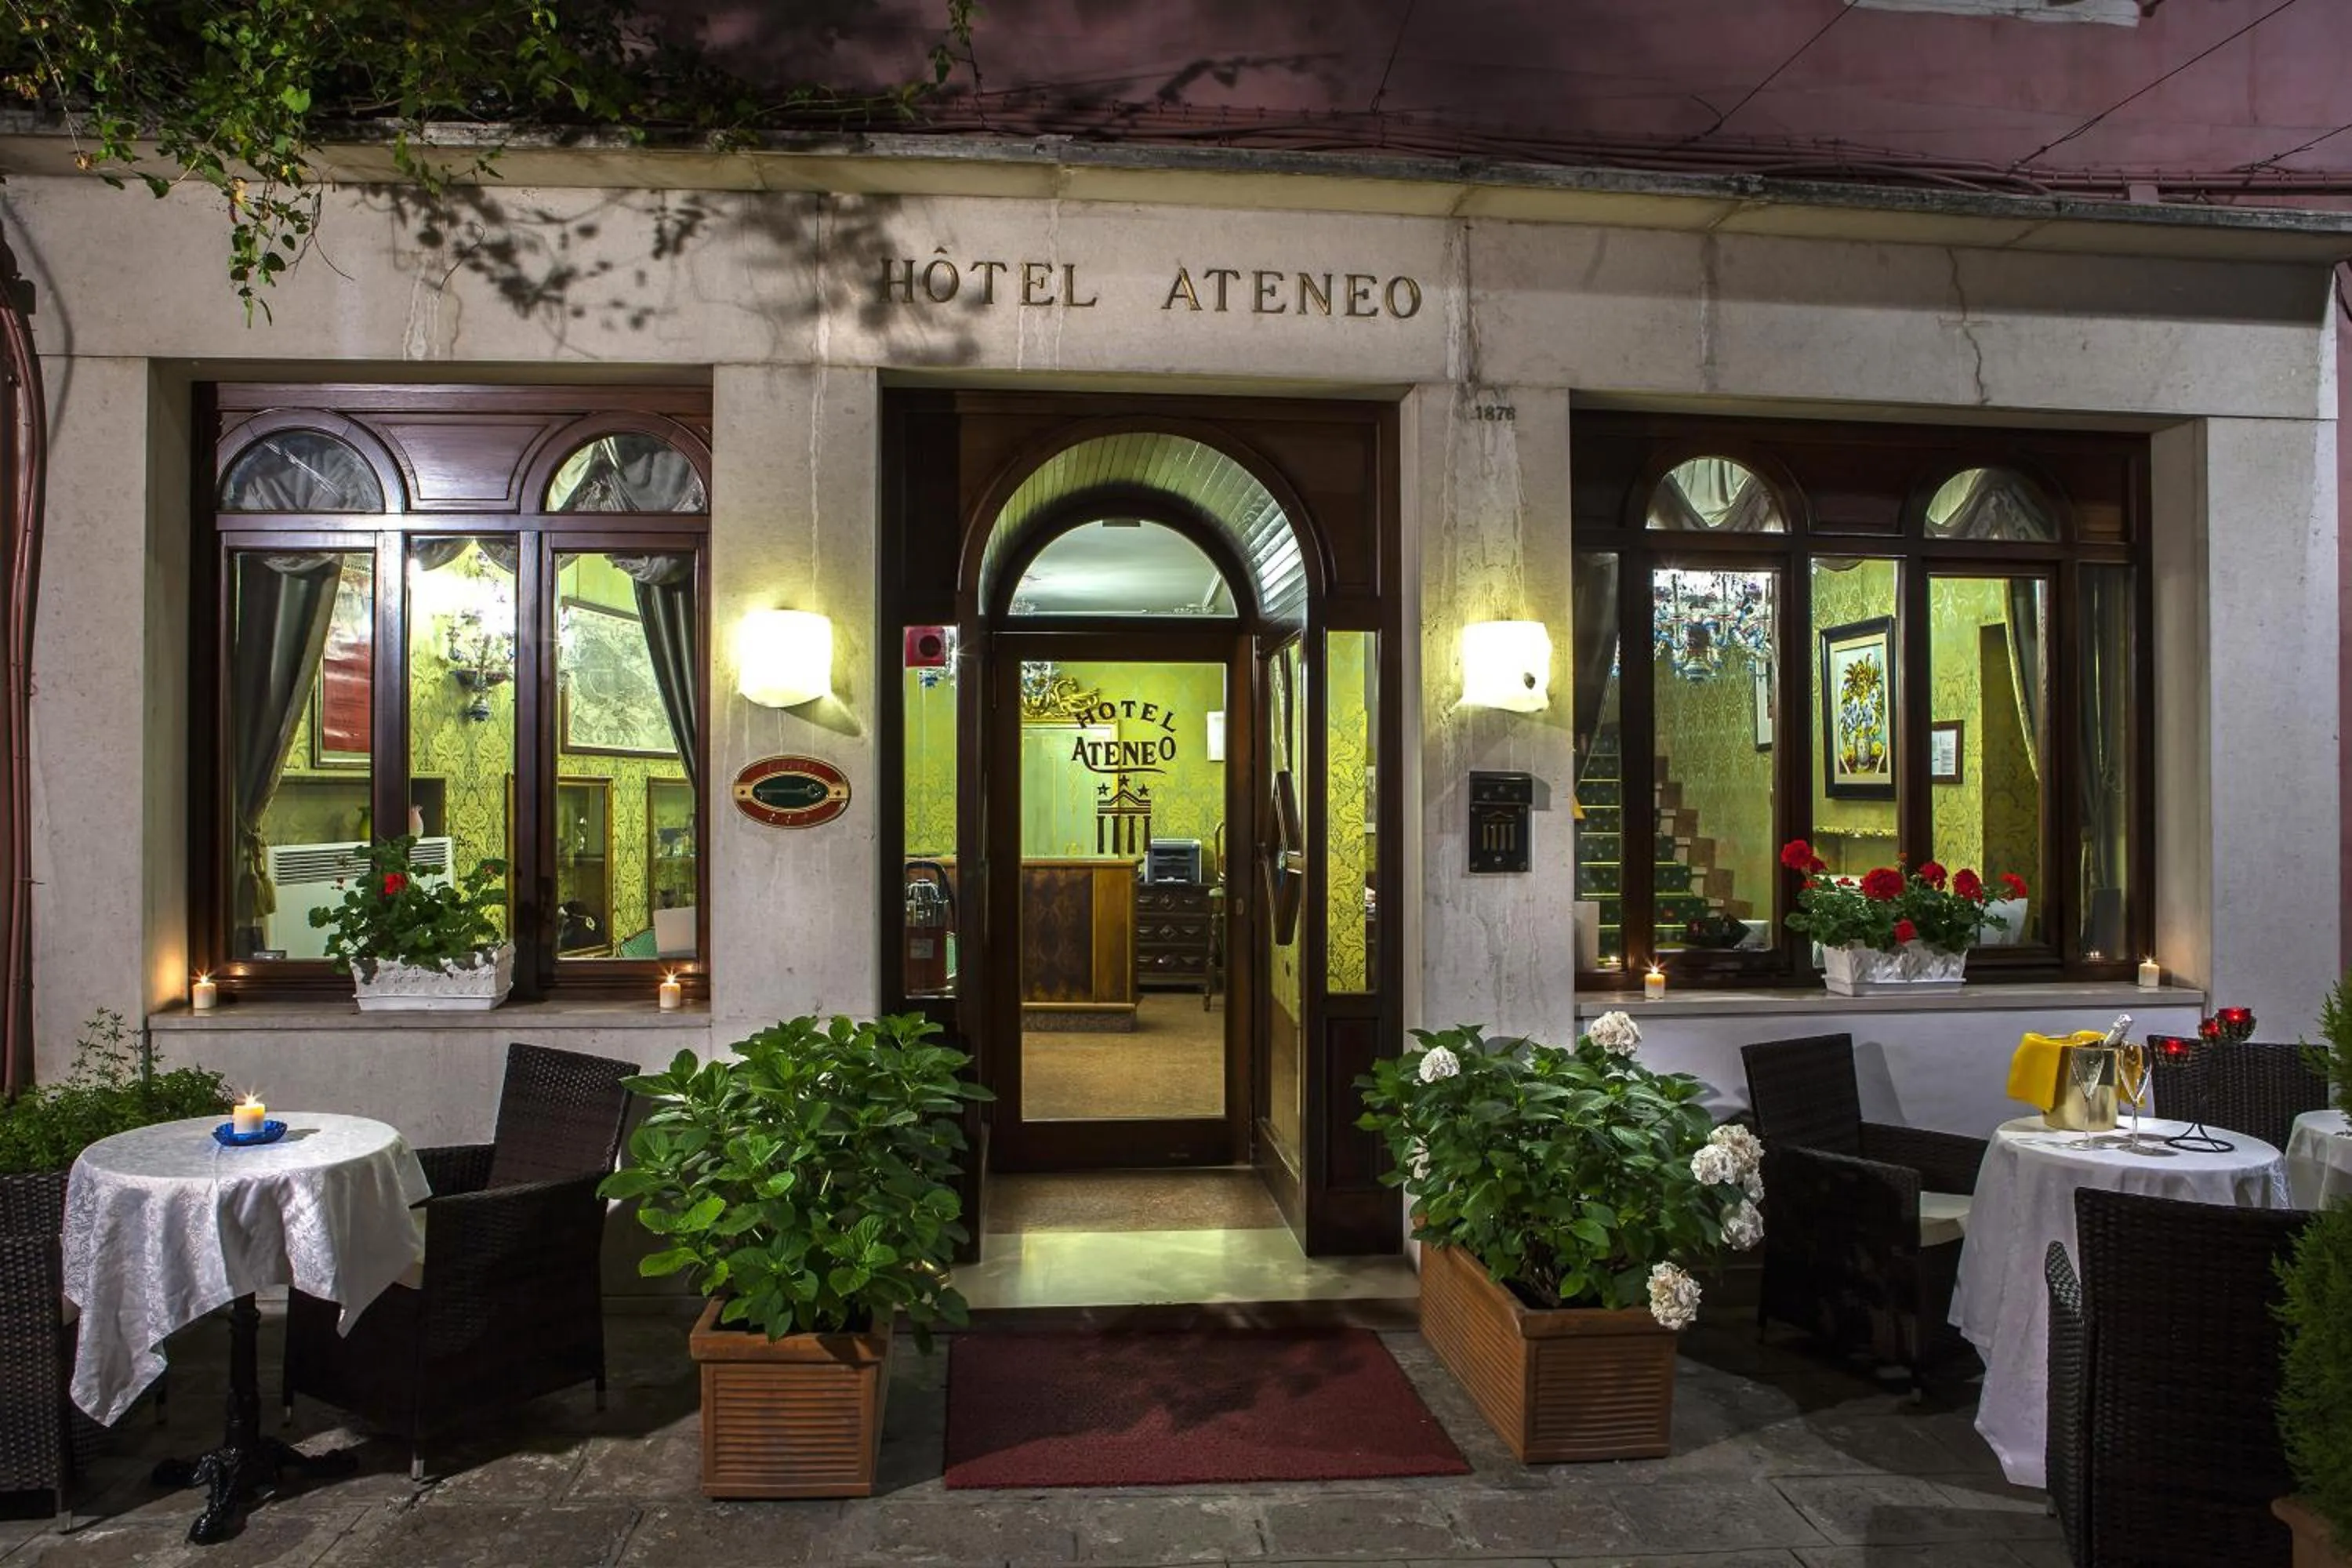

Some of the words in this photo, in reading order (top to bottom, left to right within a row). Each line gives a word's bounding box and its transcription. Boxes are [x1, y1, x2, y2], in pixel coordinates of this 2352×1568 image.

[876, 246, 1098, 307] HÔTEL
[1160, 263, 1422, 319] ATENEO
[1075, 700, 1176, 732] HOTEL
[1071, 735, 1176, 774] ATENEO
